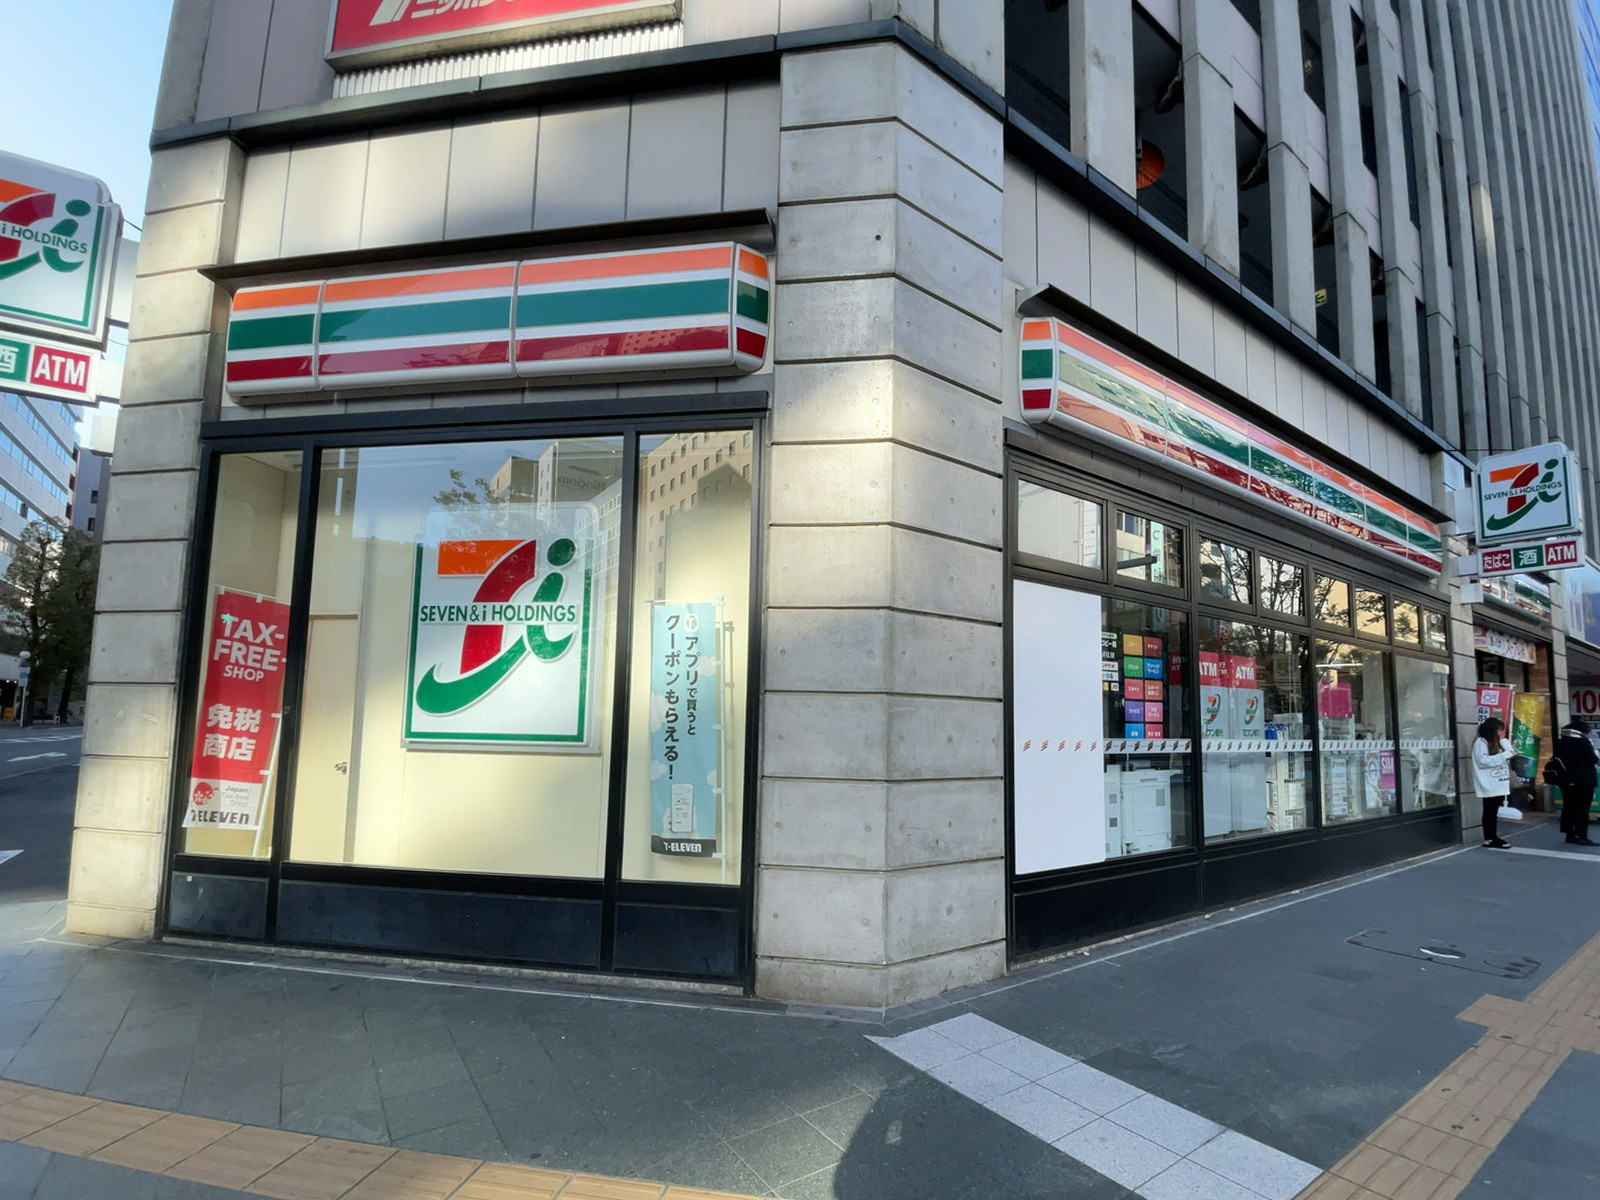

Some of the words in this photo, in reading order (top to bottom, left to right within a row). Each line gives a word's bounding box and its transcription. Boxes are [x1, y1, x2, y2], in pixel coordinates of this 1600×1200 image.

[11, 225, 88, 254] HOLDINGS
[34, 352, 86, 387] ATM
[1520, 481, 1562, 496] HOLDINGS
[1483, 551, 1511, 570] たばこ
[1519, 549, 1537, 566] 酒
[1547, 545, 1575, 562] ATM
[492, 604, 576, 622] HOLDINGS
[221, 614, 285, 647] TAX-
[213, 639, 282, 672] FREE
[223, 665, 264, 682] SHOP
[685, 636, 701, 736] アプリで買うと
[1235, 666, 1255, 680] ATM
[663, 613, 681, 780] クーポンもらえる！
[1572, 690, 1600, 714] 10
[206, 703, 261, 733] 免税
[202, 733, 256, 762] 商店
